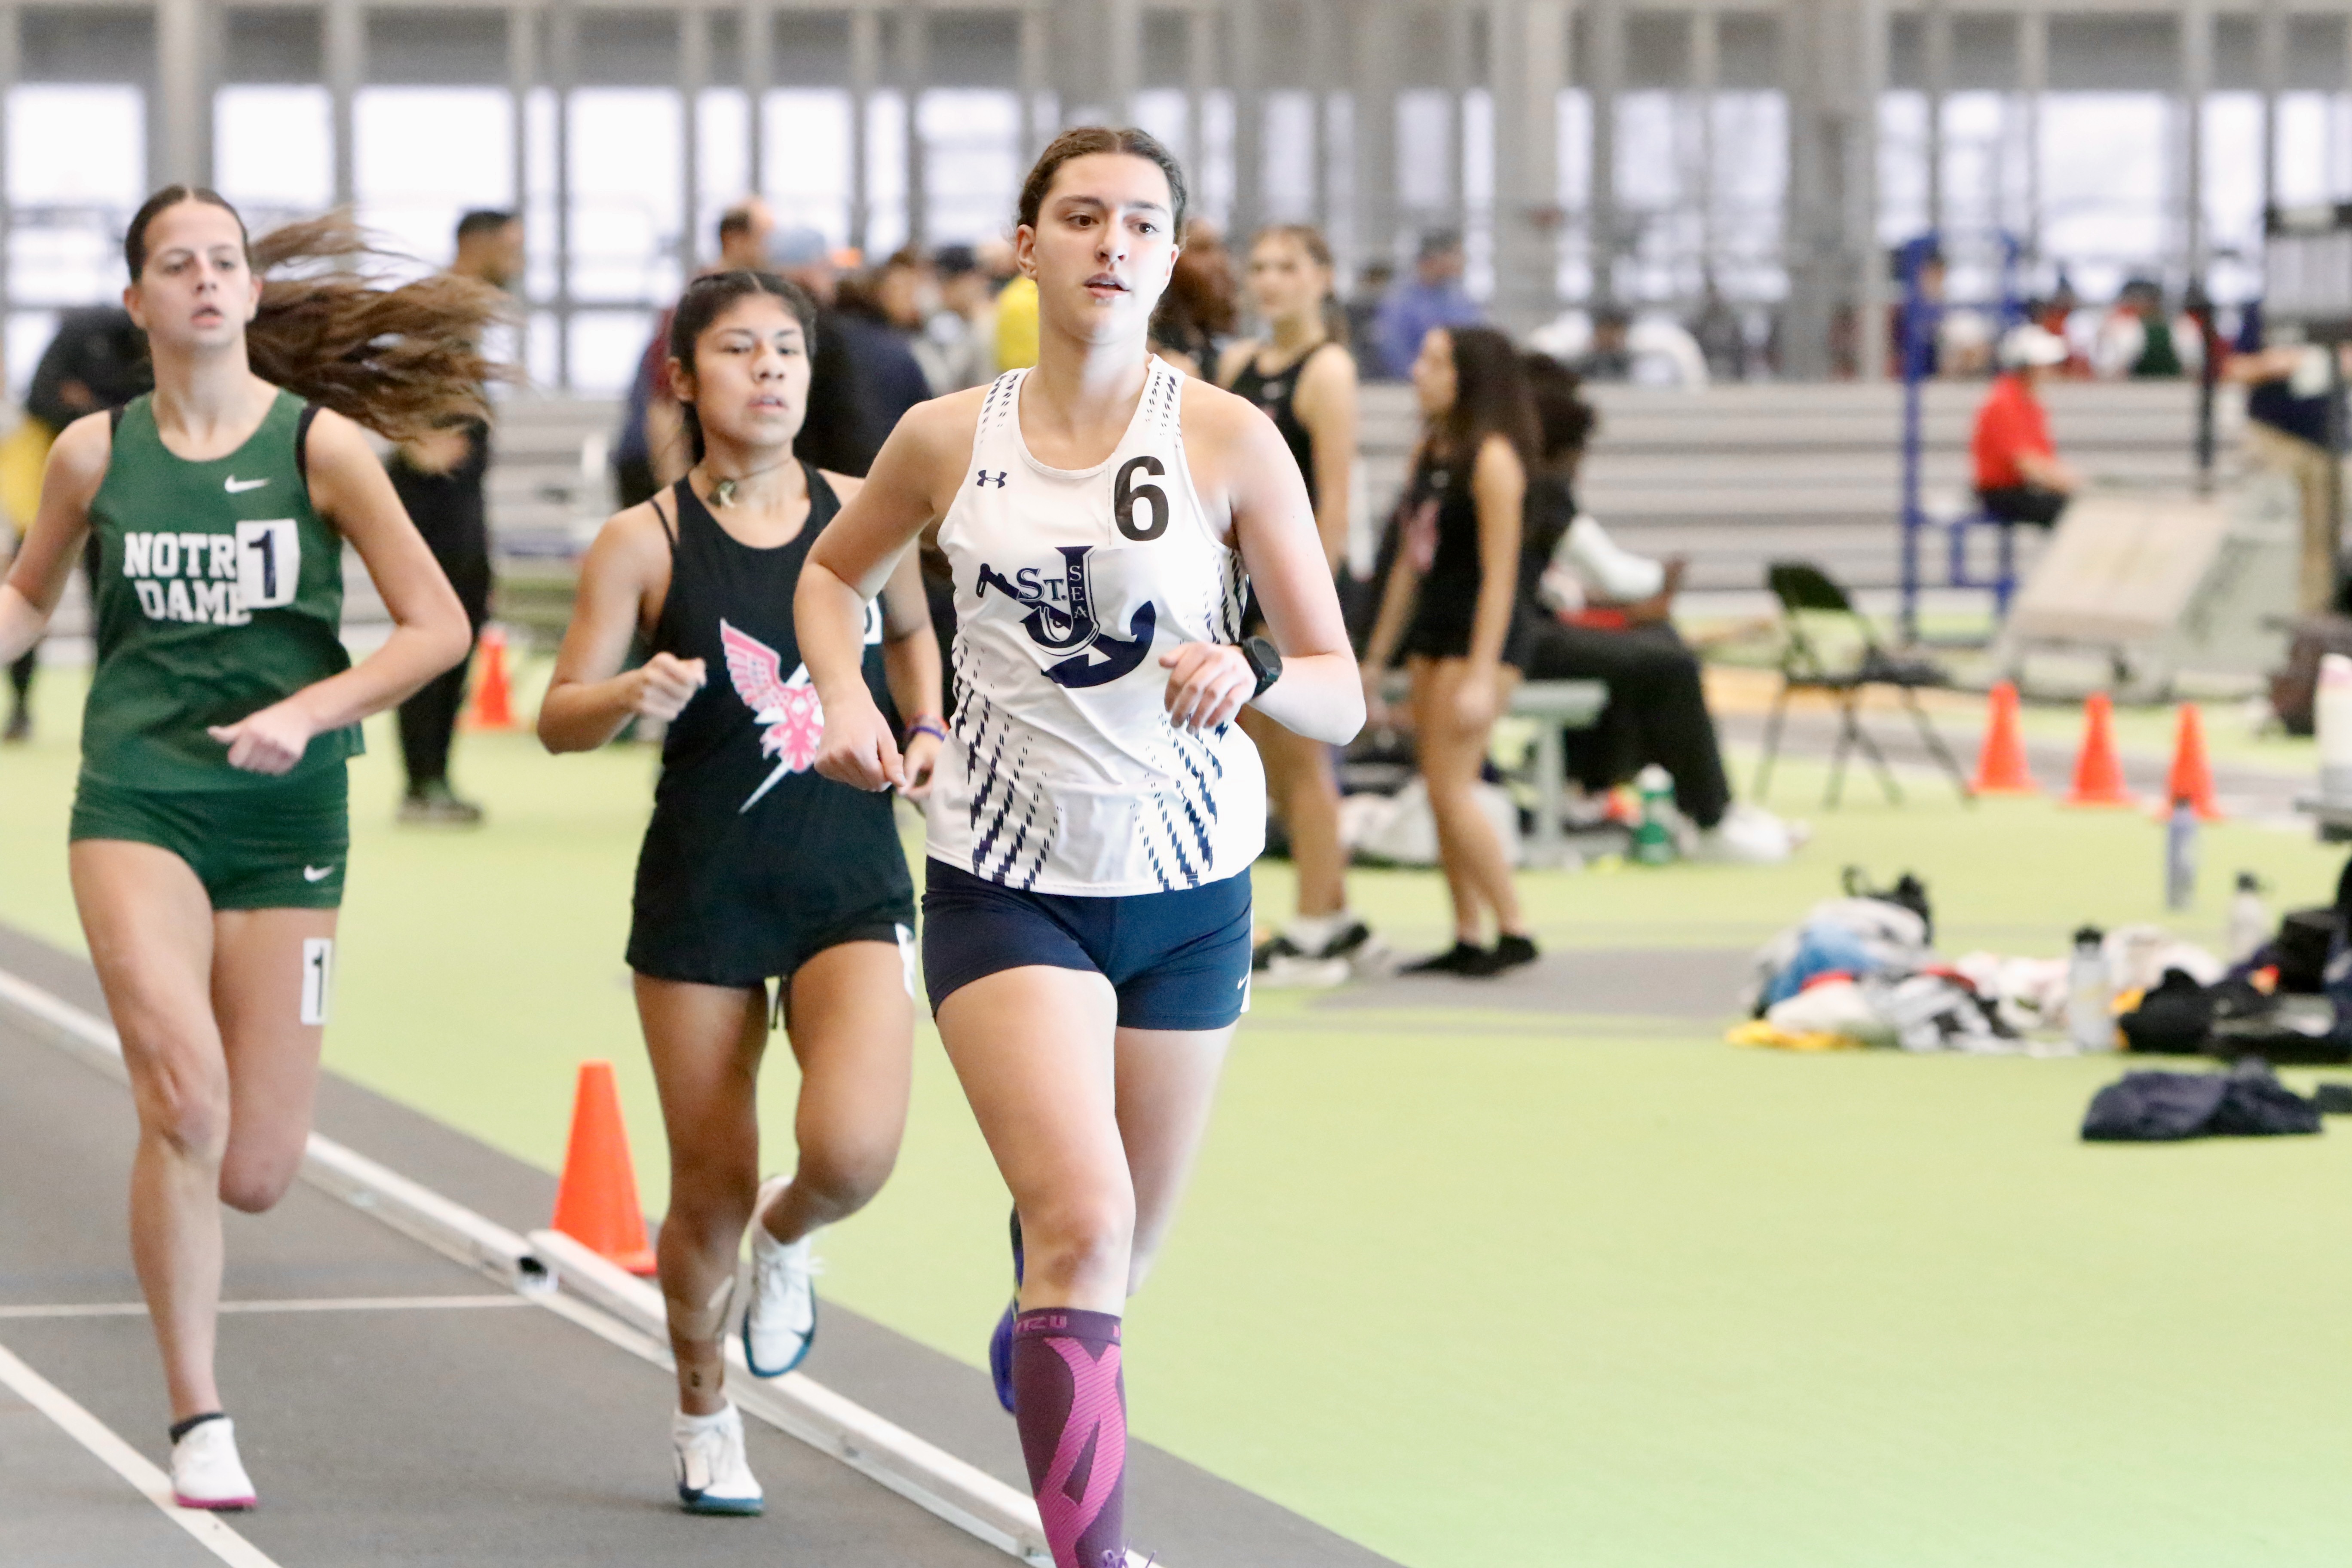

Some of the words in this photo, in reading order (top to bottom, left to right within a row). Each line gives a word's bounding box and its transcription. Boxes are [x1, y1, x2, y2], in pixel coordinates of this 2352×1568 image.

[1113, 456, 1170, 542] 6
[122, 533, 237, 578] NOTR
[248, 528, 276, 598] 1
[1069, 565, 1089, 619] SEA
[312, 946, 324, 1016] 1
